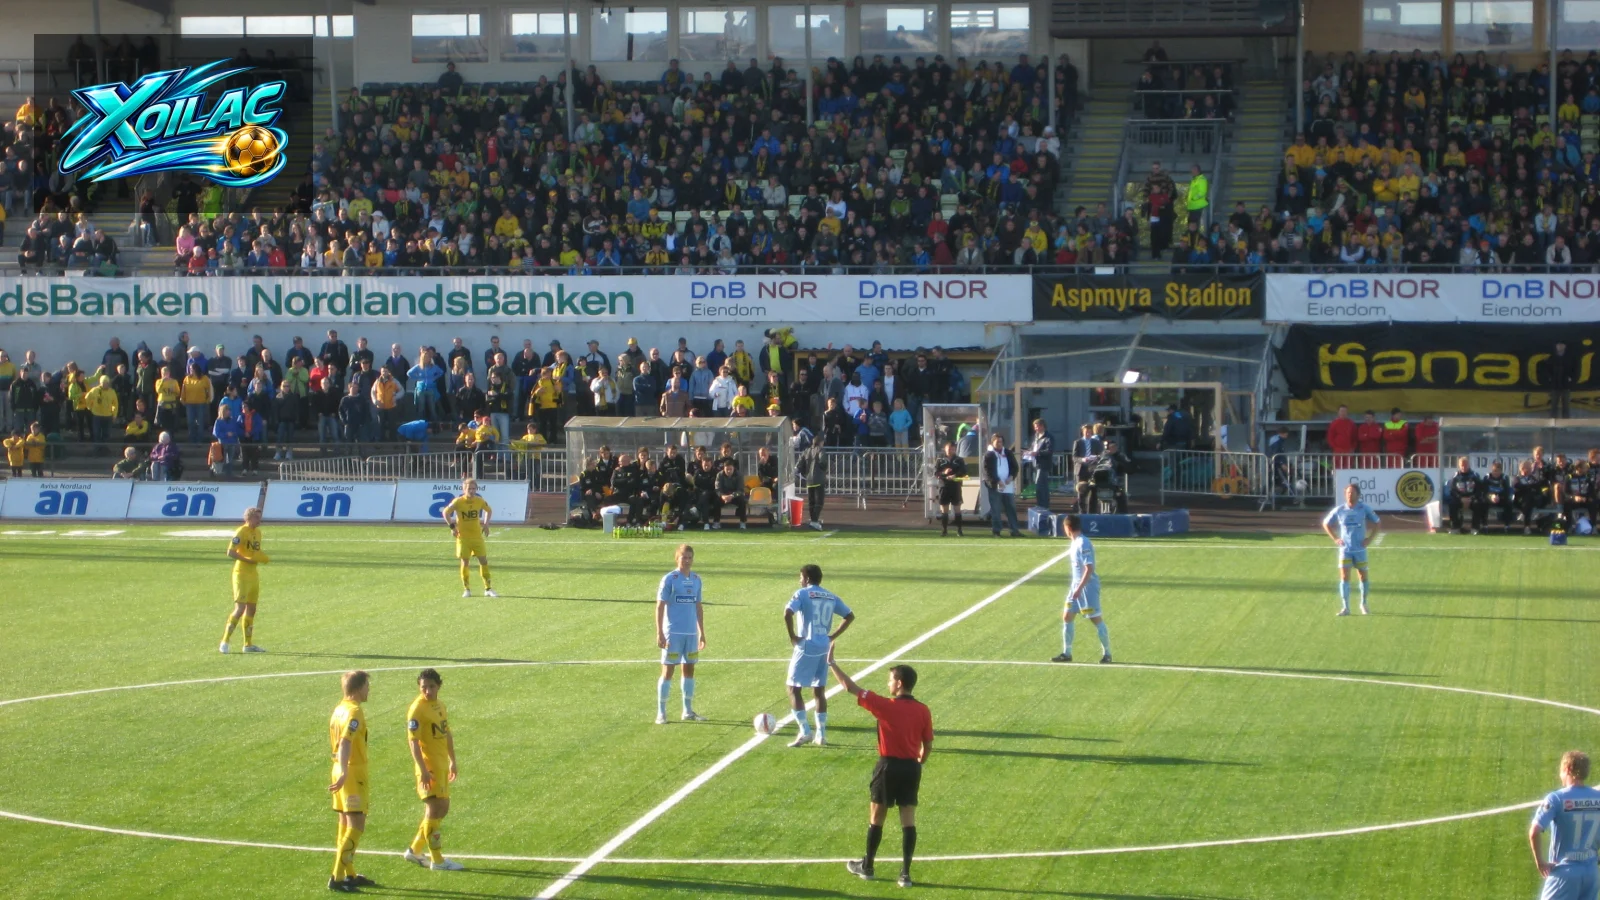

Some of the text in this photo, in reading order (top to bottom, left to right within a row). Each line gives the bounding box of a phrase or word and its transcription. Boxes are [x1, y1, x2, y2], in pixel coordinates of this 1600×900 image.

[691, 281, 818, 299] DnB NOR
[859, 280, 988, 299] DnB NOR
[1052, 282, 1251, 312] Aspmyra Stadion
[1308, 279, 1440, 299] DnB NOR
[1482, 279, 1600, 299] DnB NO
[251, 283, 634, 316] NordlandsBanken
[691, 303, 767, 317] Eiendom
[859, 303, 936, 317] Eiendom
[1307, 303, 1386, 317] Eiendom
[1481, 303, 1562, 317] Eiendom
[34, 490, 89, 515] an
[161, 493, 216, 517] an
[296, 492, 352, 518] an
[812, 600, 835, 628] 30
[1574, 799, 1600, 808] BILGLA
[1572, 812, 1600, 850] 17
